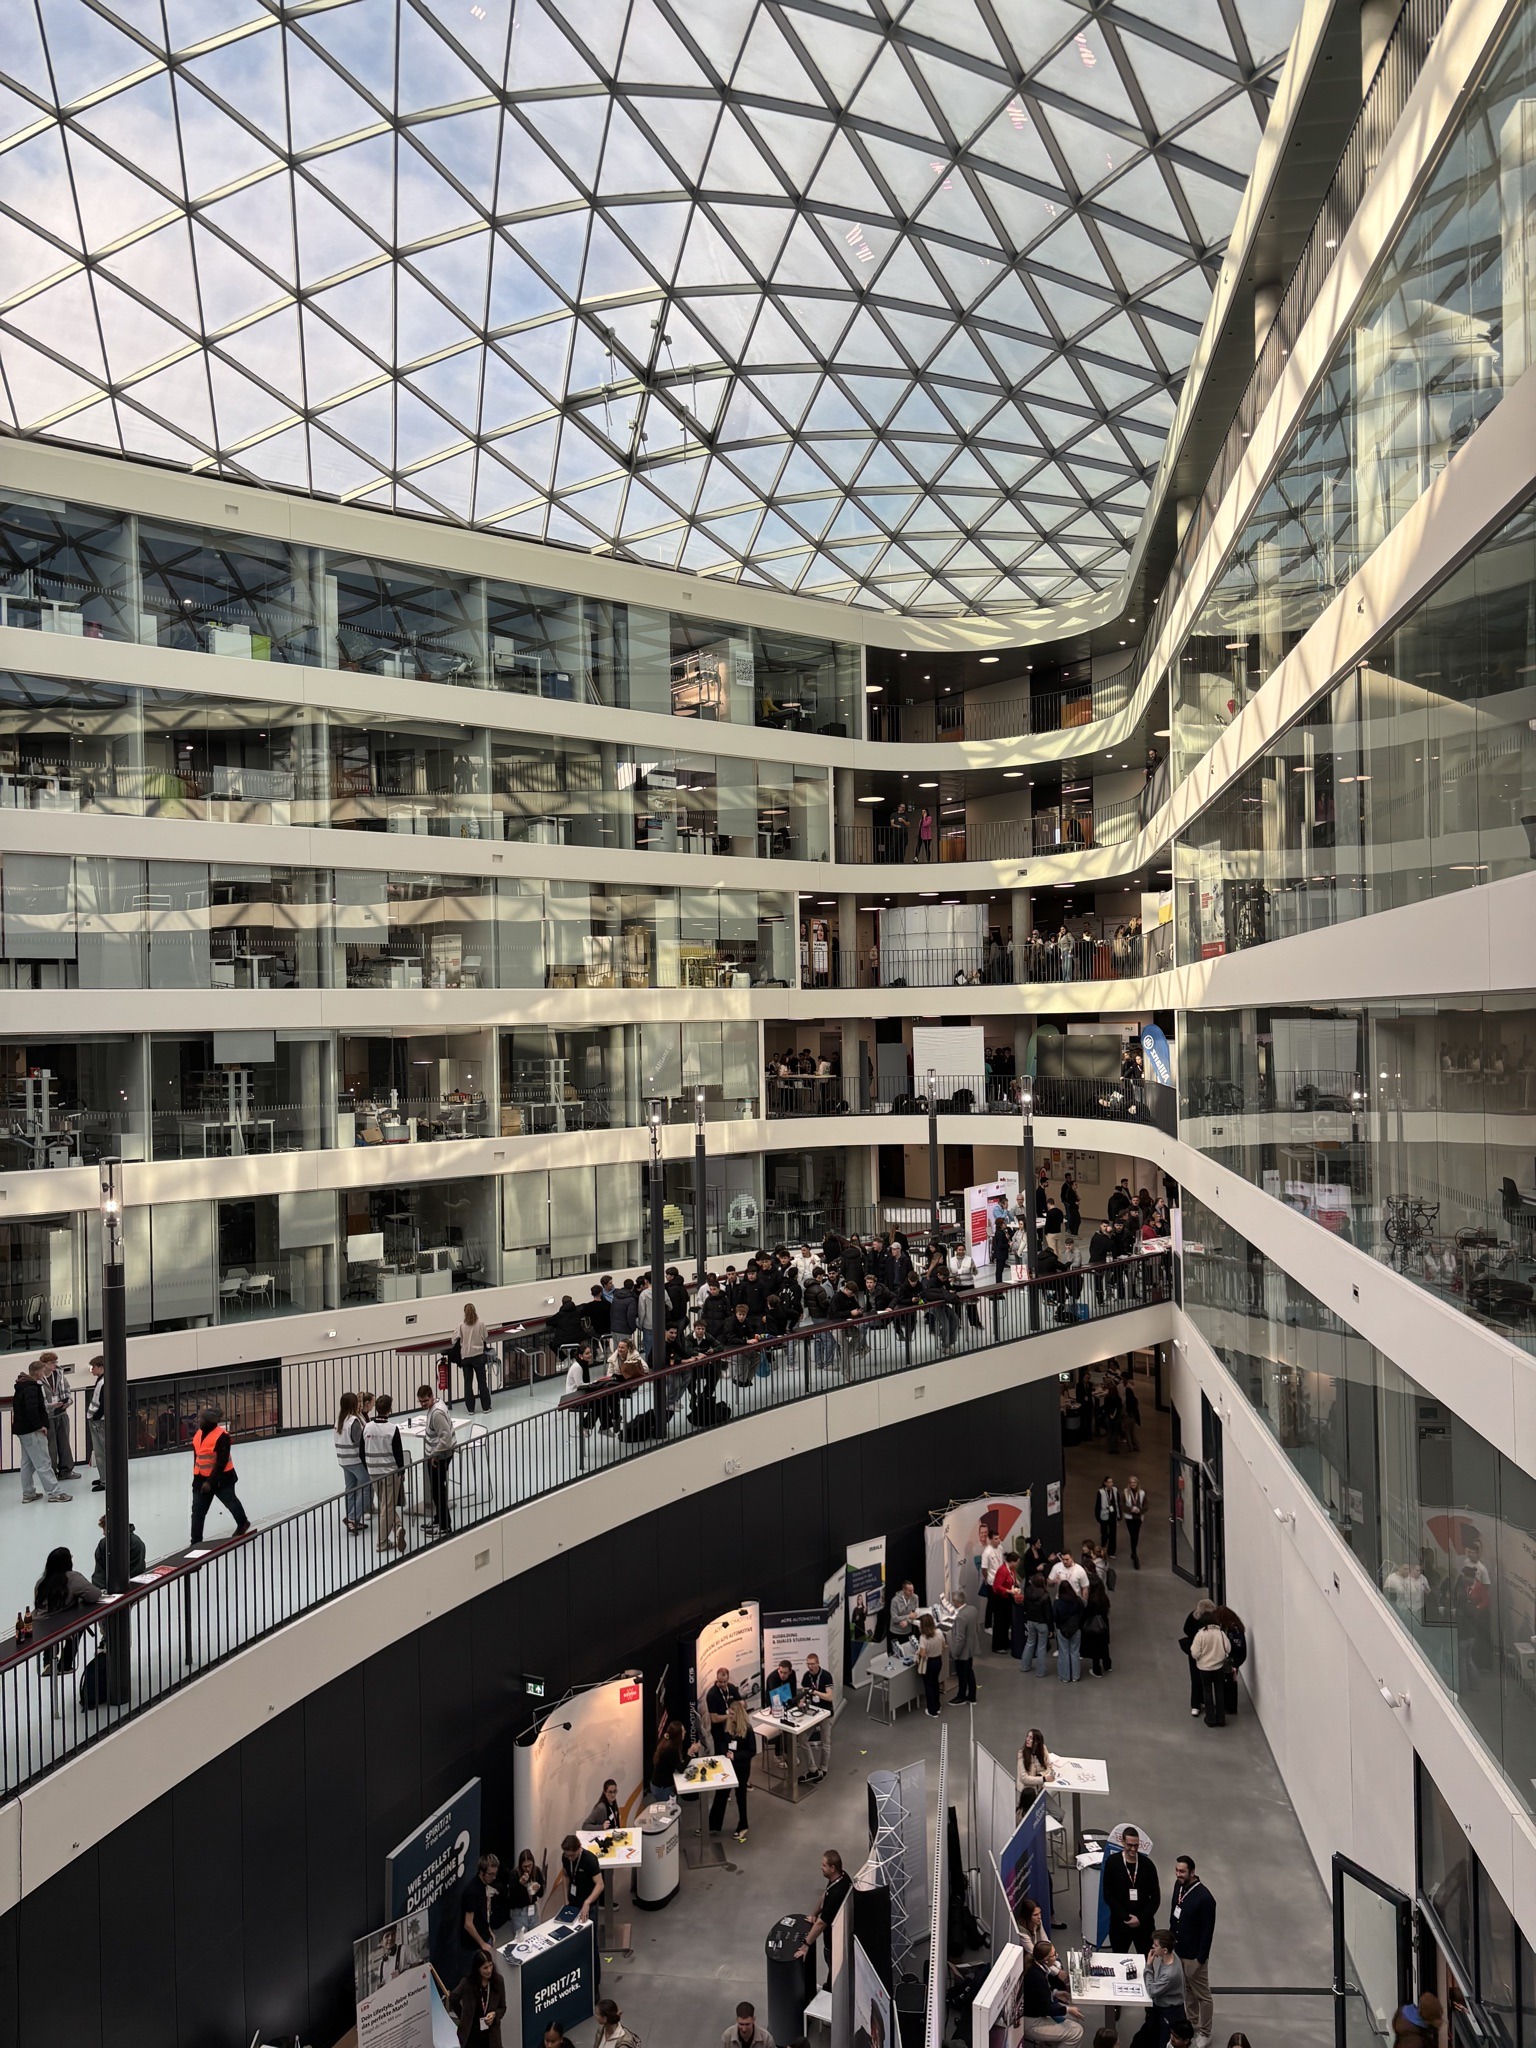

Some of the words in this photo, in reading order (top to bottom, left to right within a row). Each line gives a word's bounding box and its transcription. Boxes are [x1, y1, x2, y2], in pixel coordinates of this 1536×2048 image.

[655, 1049, 669, 1072] Allianz
[729, 1626, 753, 1640] AUTOMOTIVE
[792, 1615, 821, 1623] AUTOMOTIVE
[425, 1812, 452, 1843] SPIRIT/21
[430, 1836, 439, 1846] that
[454, 1829, 471, 1878] ?
[406, 1888, 421, 1914] DU
[422, 1879, 435, 1899] DIR
[435, 1857, 457, 1885] DEINE
[407, 1875, 422, 1895] WIE
[423, 1846, 452, 1881] STELLST
[444, 1873, 457, 1890] VOR
[534, 1967, 581, 2004] SPIRIT/21
[535, 2004, 542, 2014] IT
[543, 1995, 558, 2009] that
[559, 1982, 581, 1999] works.
[361, 2012, 373, 2023] Dein
[373, 2003, 394, 2017] Lifestyle,
[394, 1995, 408, 2005] deine
[407, 1985, 428, 1998] Karriere:
[361, 2022, 371, 2030] das
[371, 2011, 392, 2027] perfekte
[392, 2000, 409, 2013] Match!
